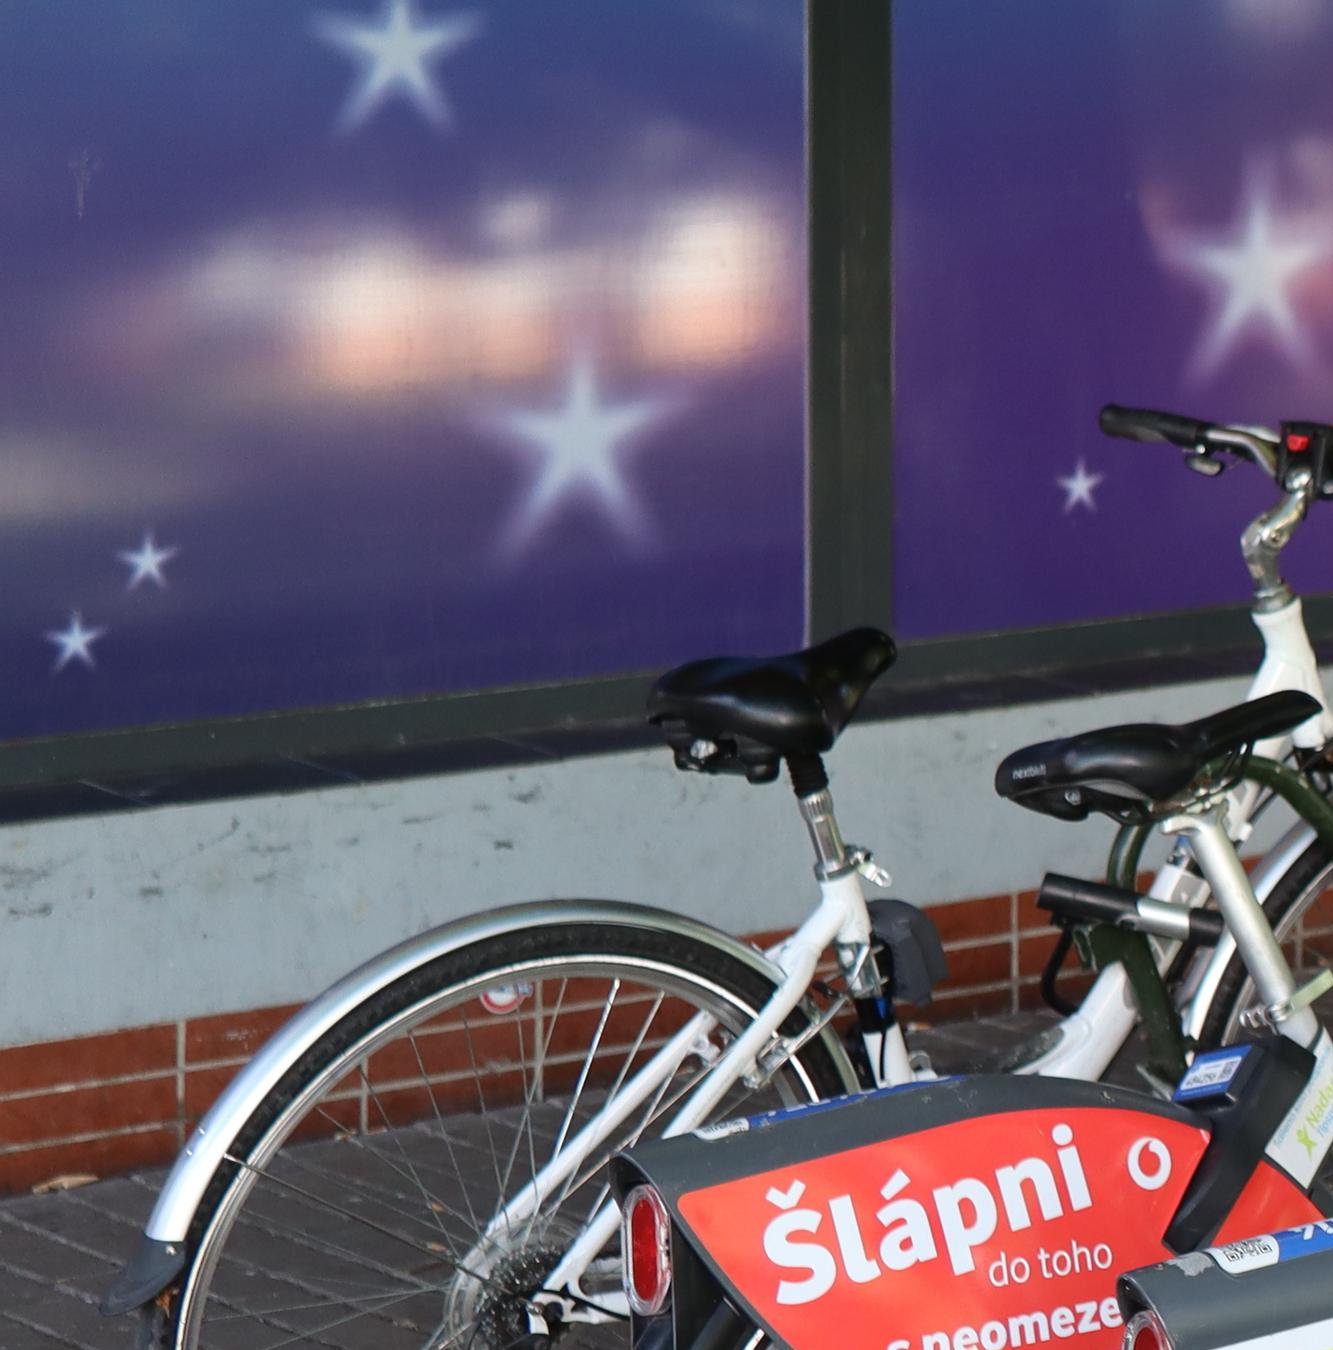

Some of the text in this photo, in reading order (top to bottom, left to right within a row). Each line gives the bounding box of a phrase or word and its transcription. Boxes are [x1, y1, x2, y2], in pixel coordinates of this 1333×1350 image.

[762, 1123, 1094, 1305] Šlápni
[988, 1240, 1113, 1289] do toho
